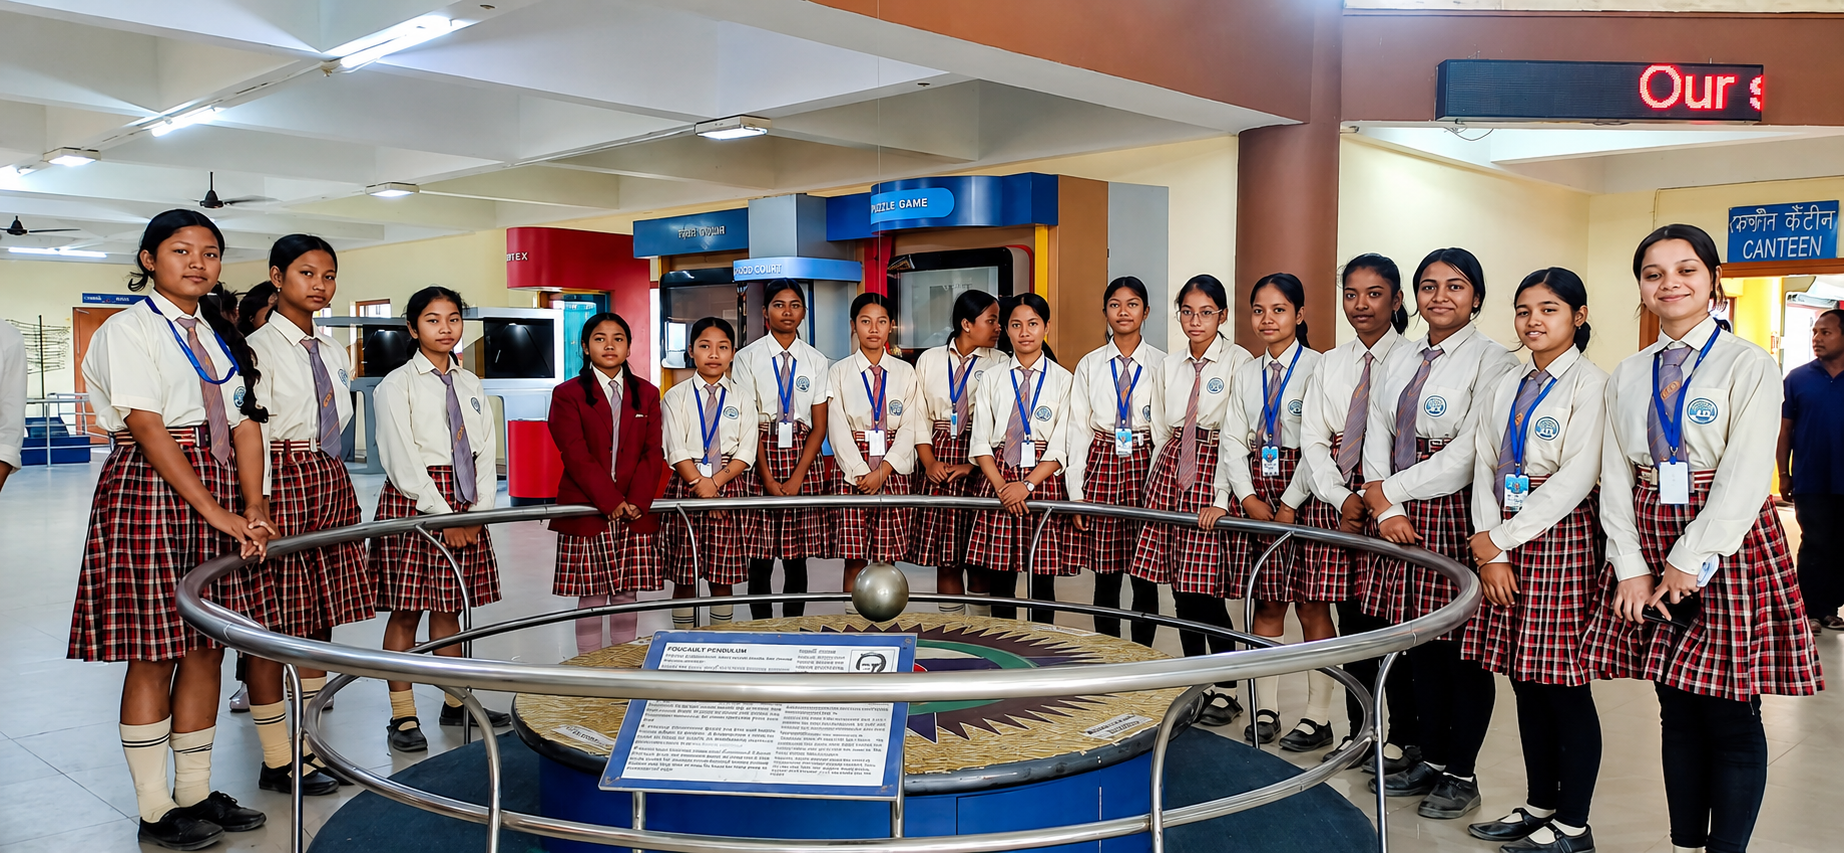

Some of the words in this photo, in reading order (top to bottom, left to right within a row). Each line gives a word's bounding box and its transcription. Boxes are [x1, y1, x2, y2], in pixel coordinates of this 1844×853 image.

[1639, 64, 1736, 111] Our
[899, 198, 928, 208] GAME
[1743, 235, 1822, 259] CANTEEN
